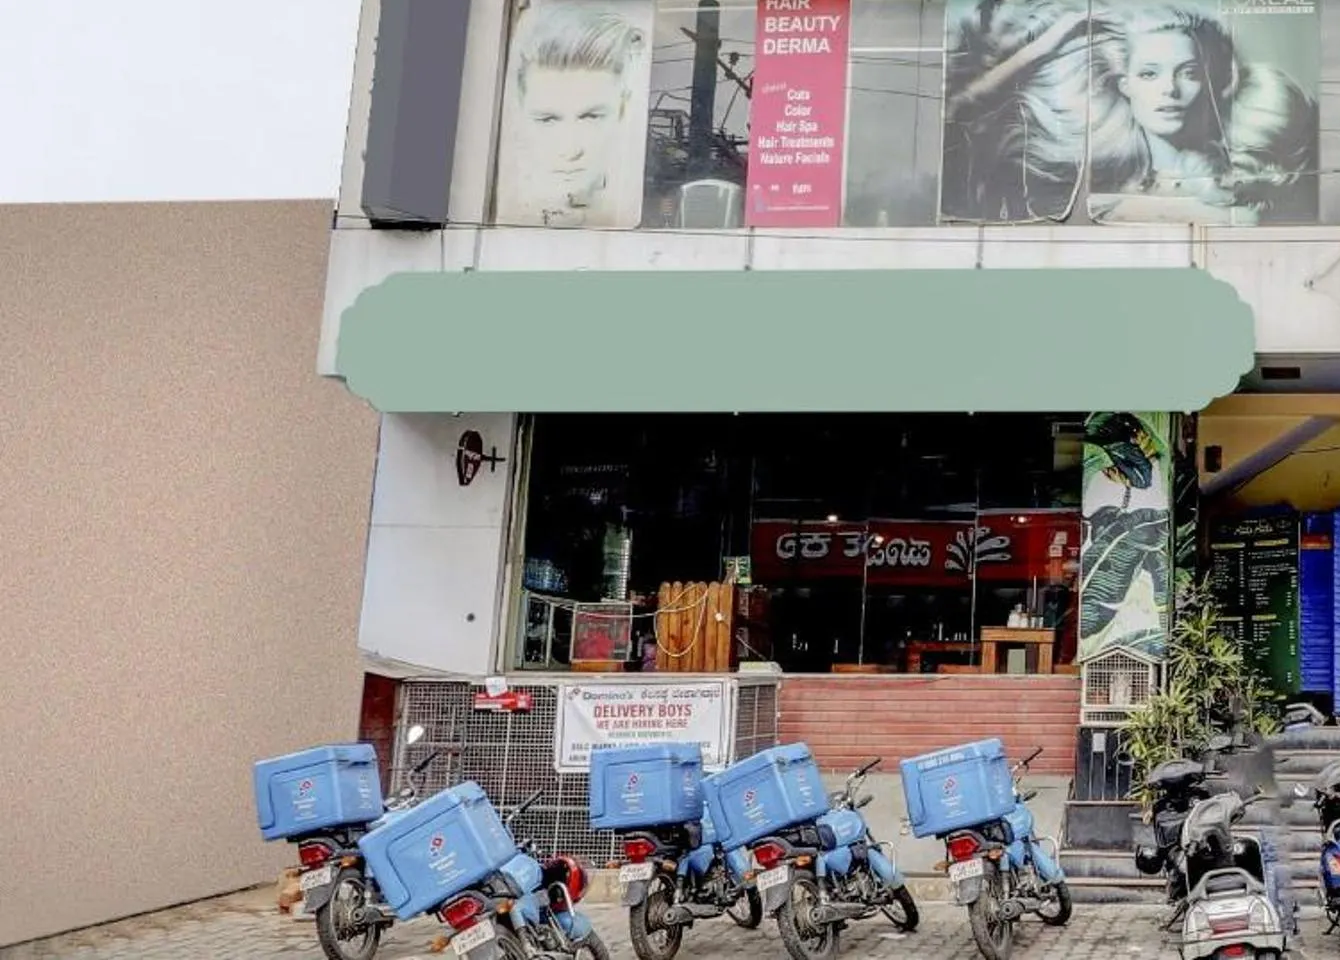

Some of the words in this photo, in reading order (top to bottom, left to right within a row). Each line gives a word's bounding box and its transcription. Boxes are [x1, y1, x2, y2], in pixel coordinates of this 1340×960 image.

[764, 15, 841, 33] BEAUTY
[763, 37, 831, 55] DERMA
[787, 88, 810, 101] Cuts
[784, 104, 812, 116] Color
[776, 121, 796, 132] Hair
[799, 120, 818, 134] Spa
[758, 136, 779, 148] Hair
[780, 136, 835, 148] Treatments
[582, 690, 633, 700] Domino's
[594, 704, 655, 719] DELIVERY
[658, 704, 692, 718] BOYS
[596, 719, 611, 730] WE
[612, 719, 628, 729] ARE
[631, 719, 663, 729] HIRING
[665, 719, 688, 729] HERE
